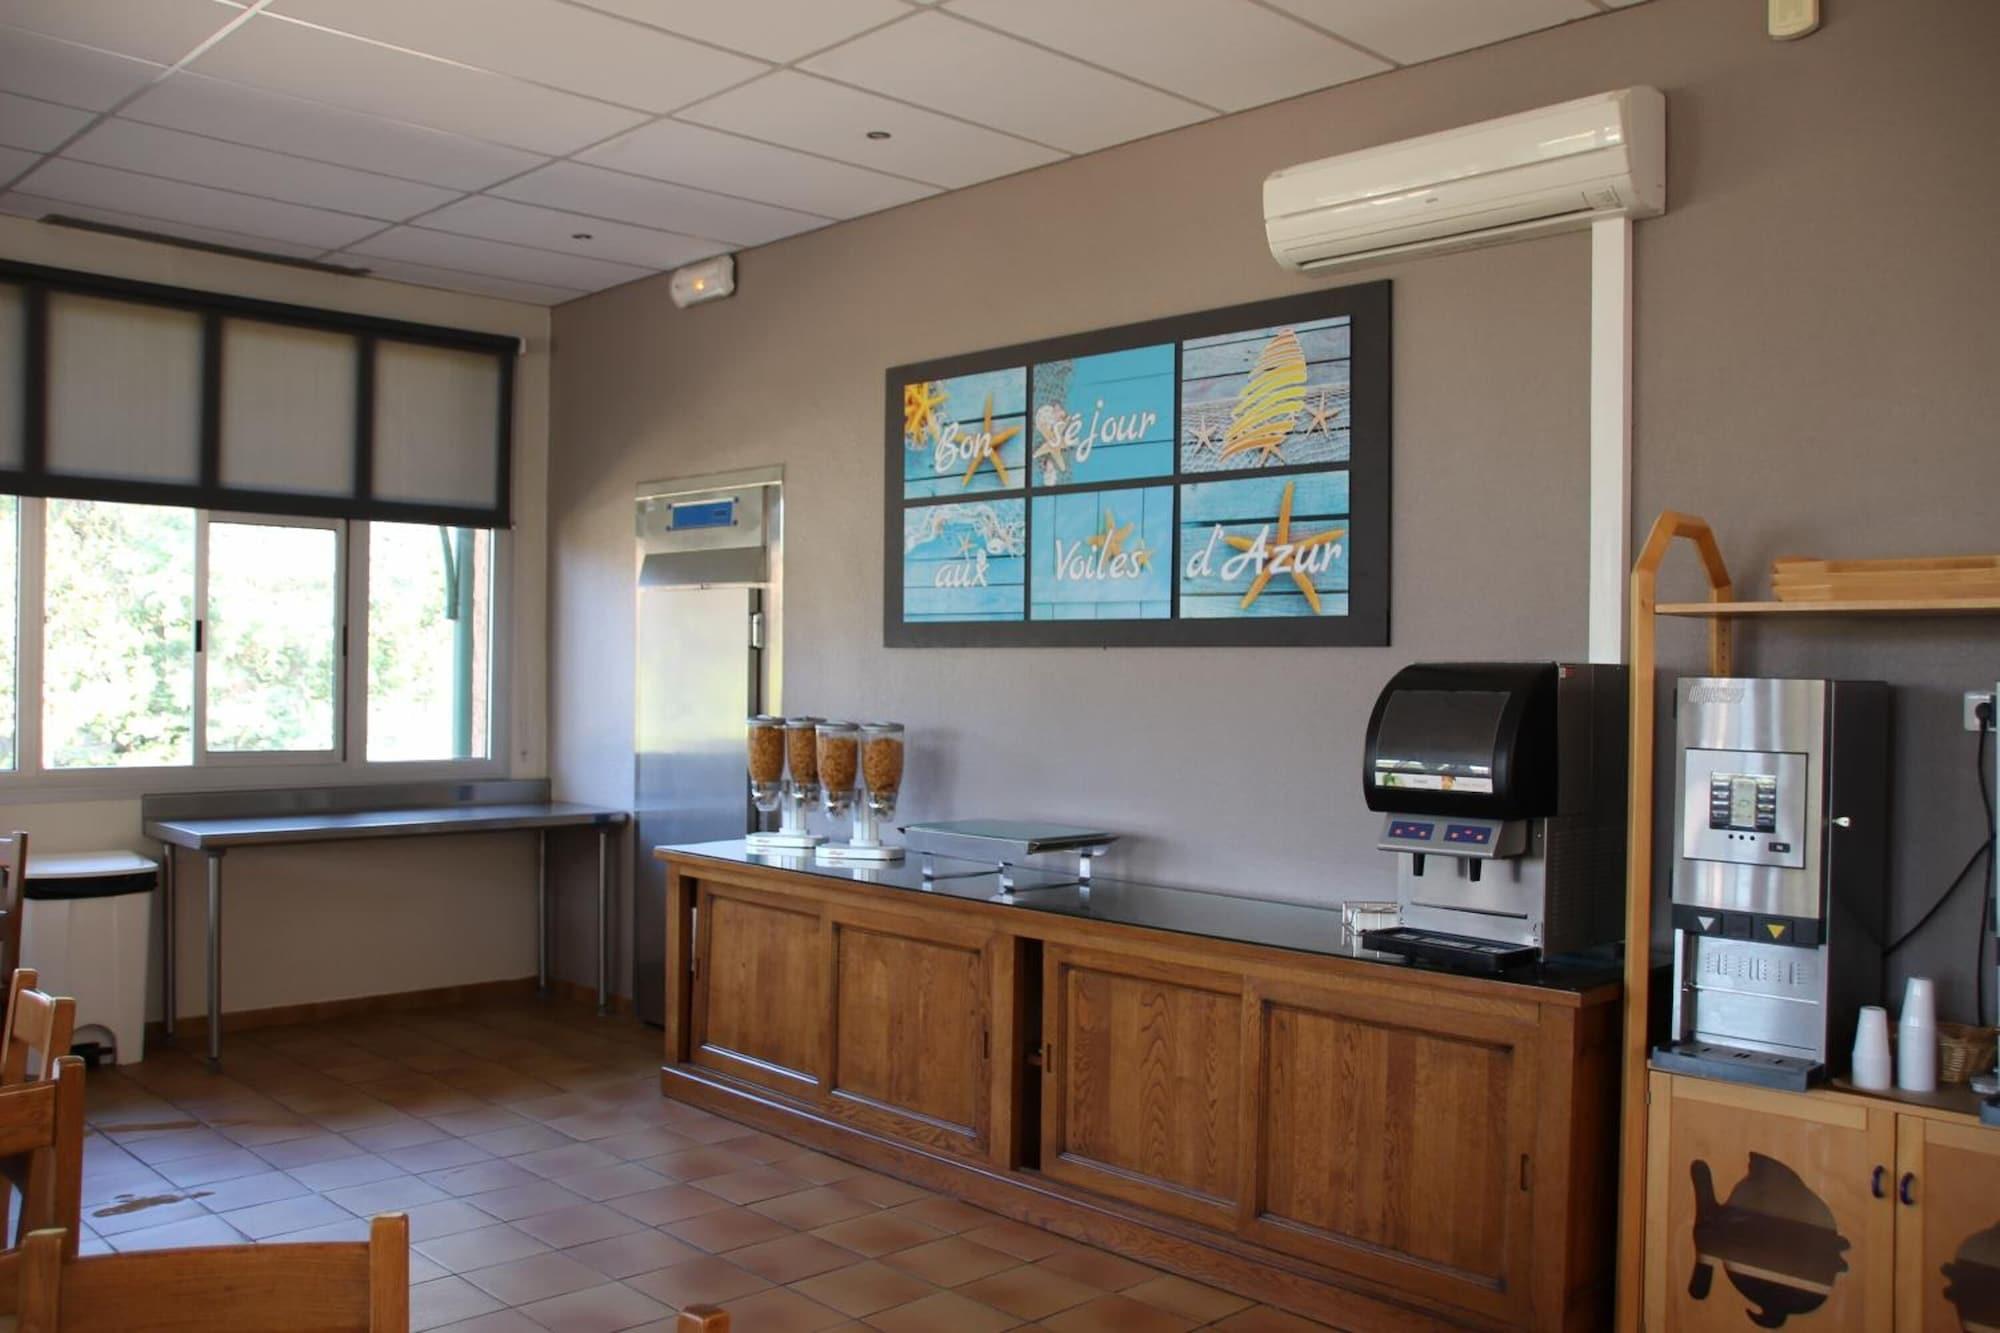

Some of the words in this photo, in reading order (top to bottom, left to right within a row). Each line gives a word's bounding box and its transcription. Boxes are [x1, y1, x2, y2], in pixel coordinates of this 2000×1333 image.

[935, 422, 993, 473] Bon
[1048, 400, 1157, 463] séjour
[934, 556, 990, 588] aux
[1056, 528, 1145, 581] Voiles
[1186, 523, 1343, 582] d'Azur
